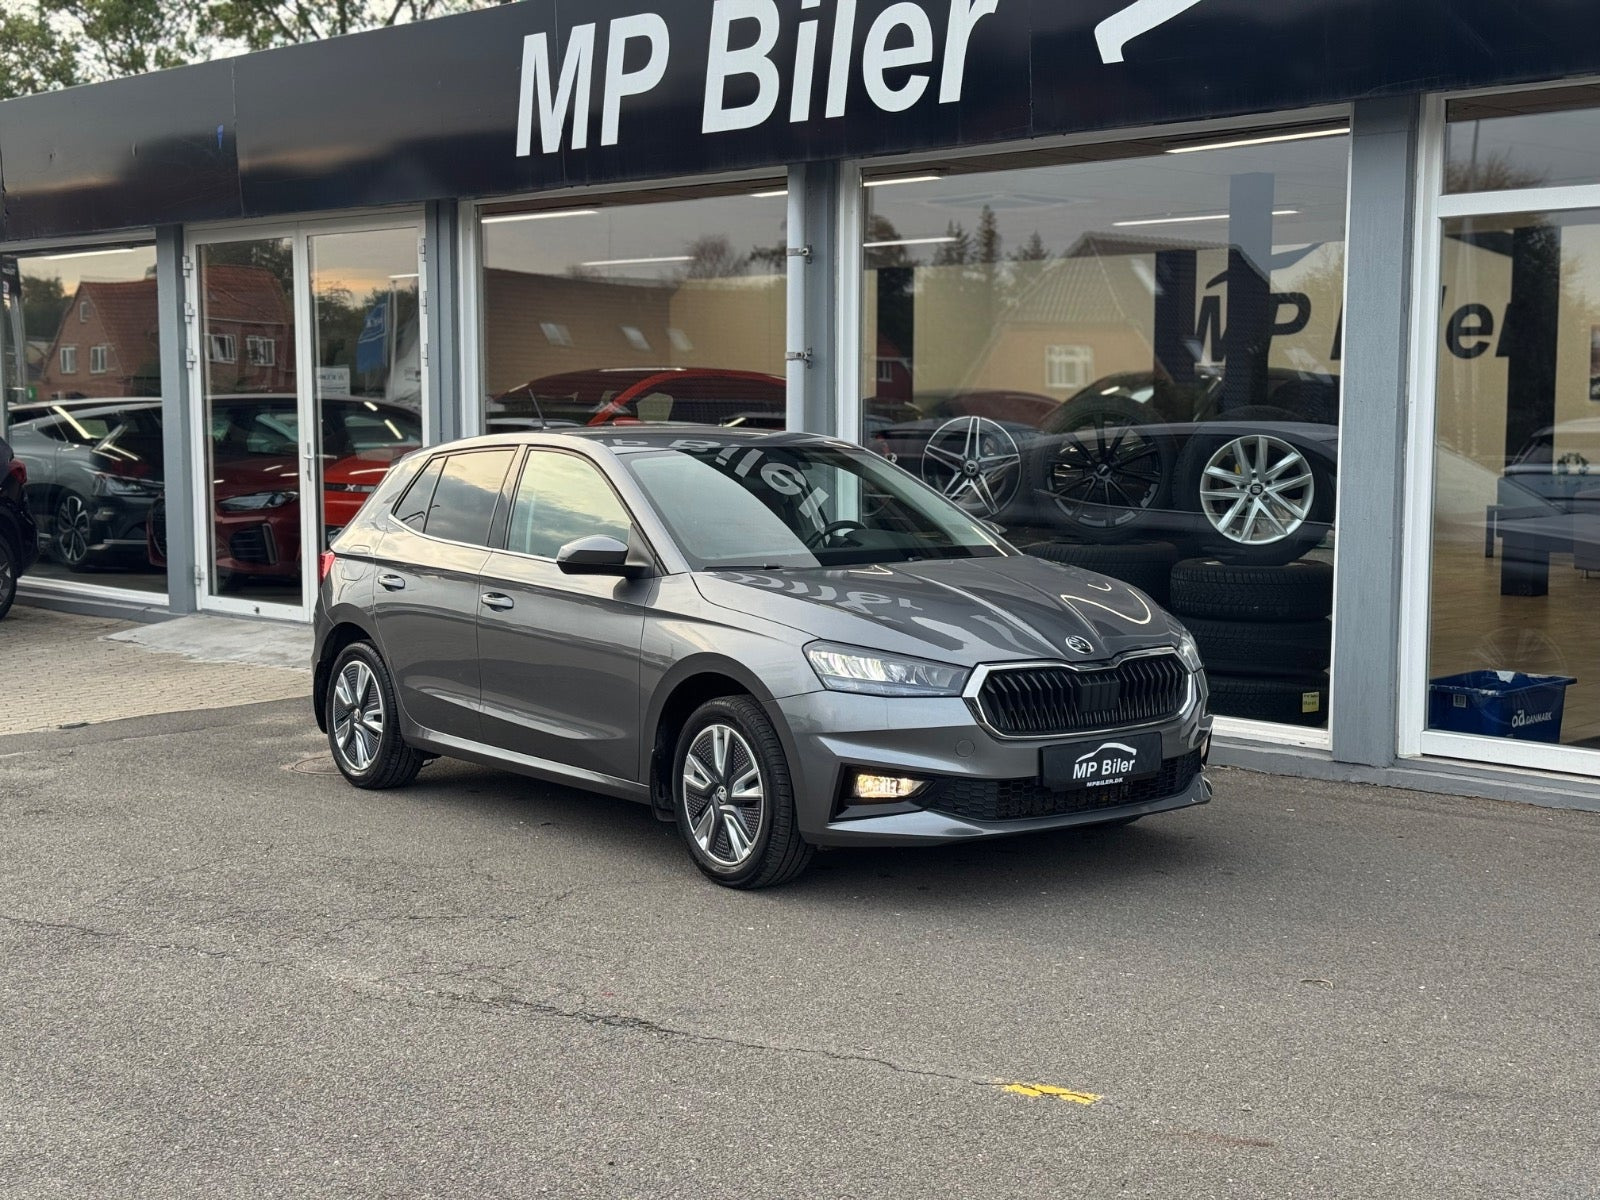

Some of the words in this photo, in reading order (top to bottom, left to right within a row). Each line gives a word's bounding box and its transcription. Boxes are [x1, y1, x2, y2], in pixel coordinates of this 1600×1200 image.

[515, 12, 670, 157] MP
[701, 0, 998, 134] Biler
[1526, 711, 1552, 724] DANMARK
[1072, 761, 1097, 779] MP
[1101, 758, 1135, 775] Biler
[1086, 777, 1123, 787] MPBILER.DK
